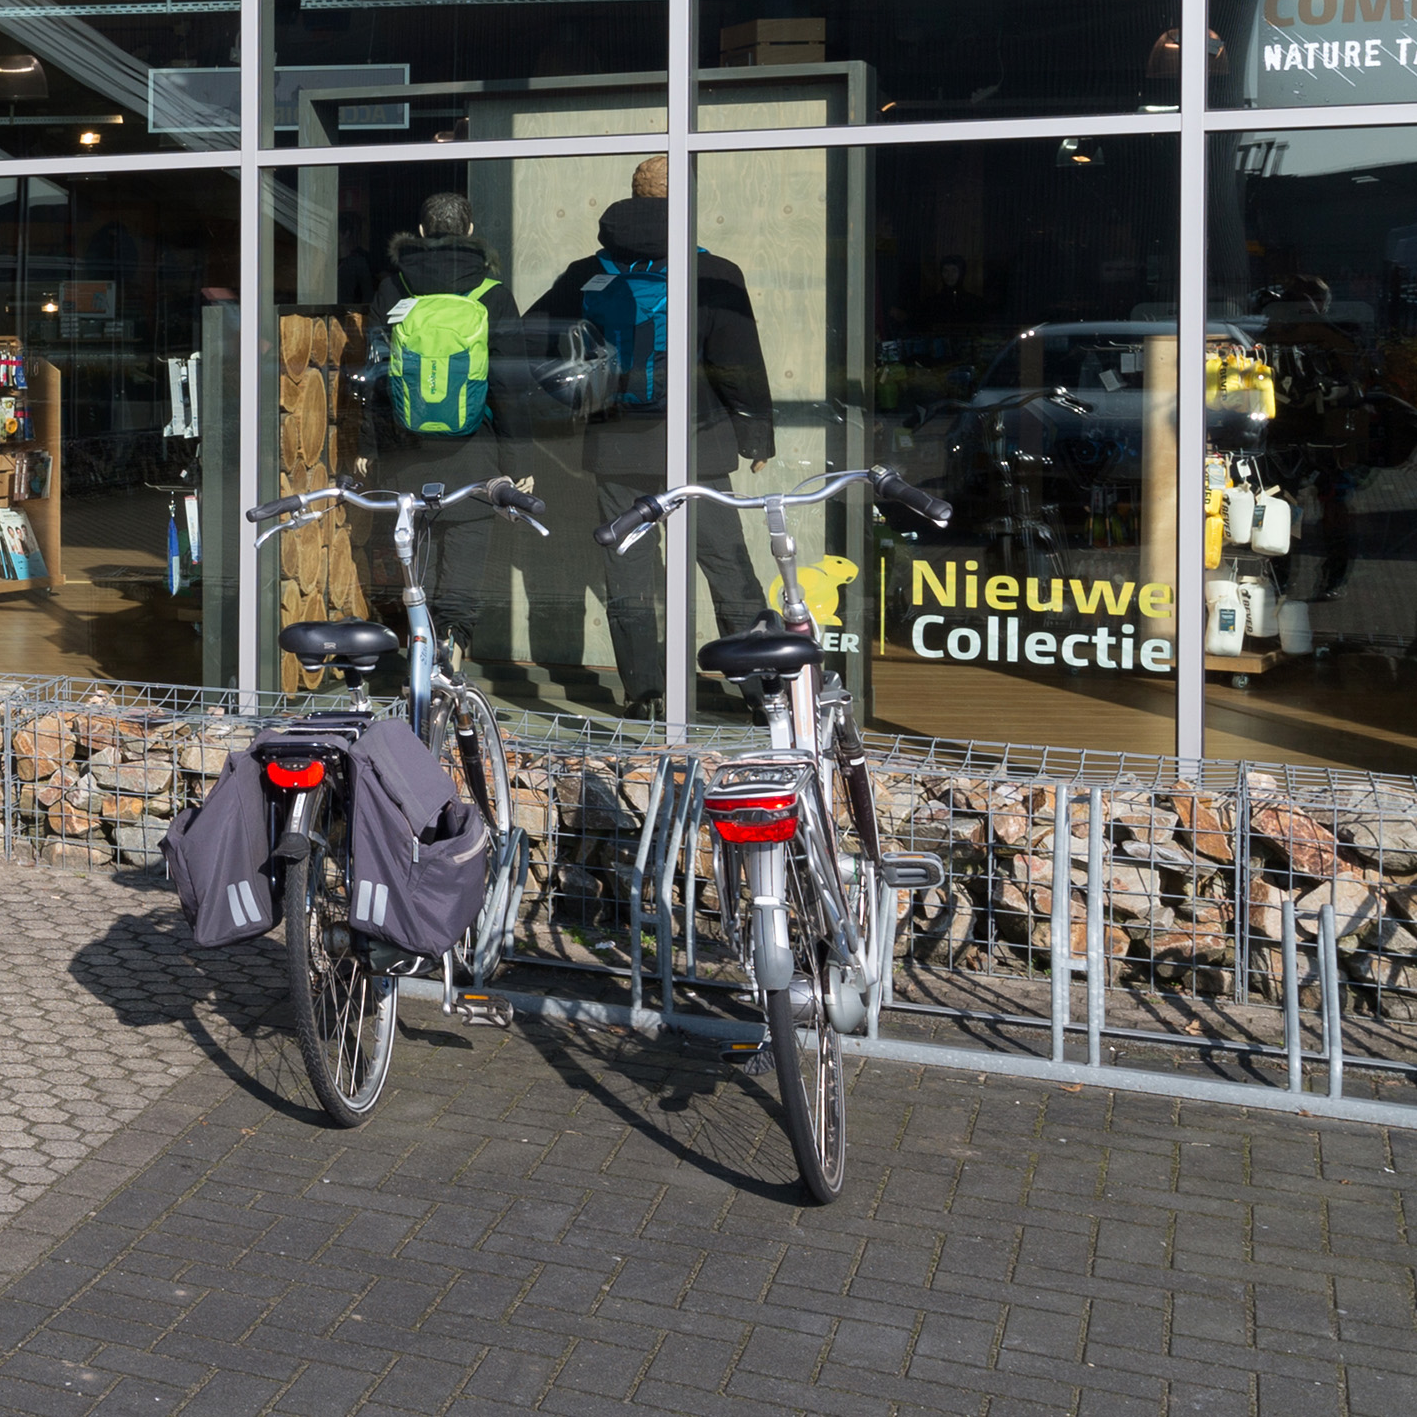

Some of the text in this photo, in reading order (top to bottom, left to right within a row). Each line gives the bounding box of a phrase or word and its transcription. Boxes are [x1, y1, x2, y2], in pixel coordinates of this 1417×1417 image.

[1264, 38, 1382, 71] NATURE
[911, 560, 1174, 618] Nieuwe
[911, 614, 1172, 672] Collectie
